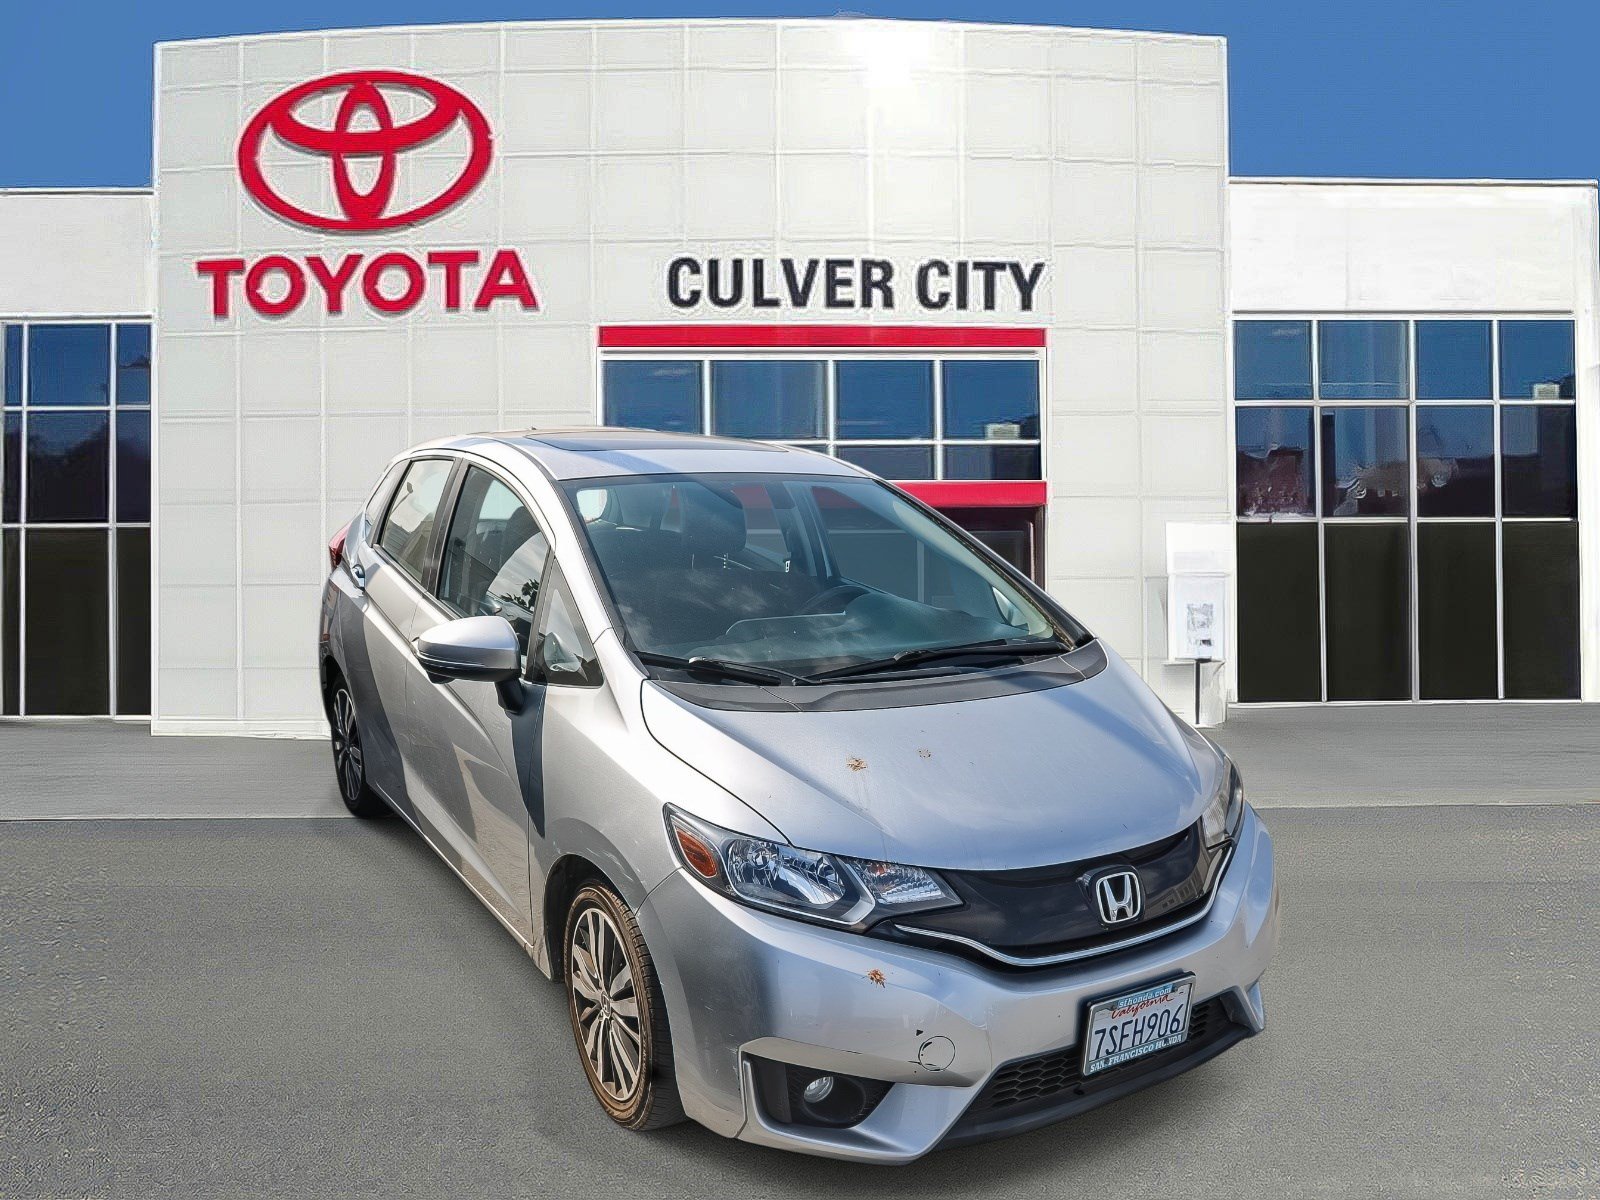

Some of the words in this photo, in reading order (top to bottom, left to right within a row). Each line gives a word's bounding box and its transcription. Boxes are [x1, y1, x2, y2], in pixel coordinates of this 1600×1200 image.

[196, 250, 538, 317] TOYOTA
[668, 258, 894, 309] CULVER
[916, 259, 1045, 311] CITY
[1094, 1004, 1183, 1060] 7SFH906
[1111, 995, 1174, 1019] California
[1108, 1043, 1155, 1066] FRANCISCO
